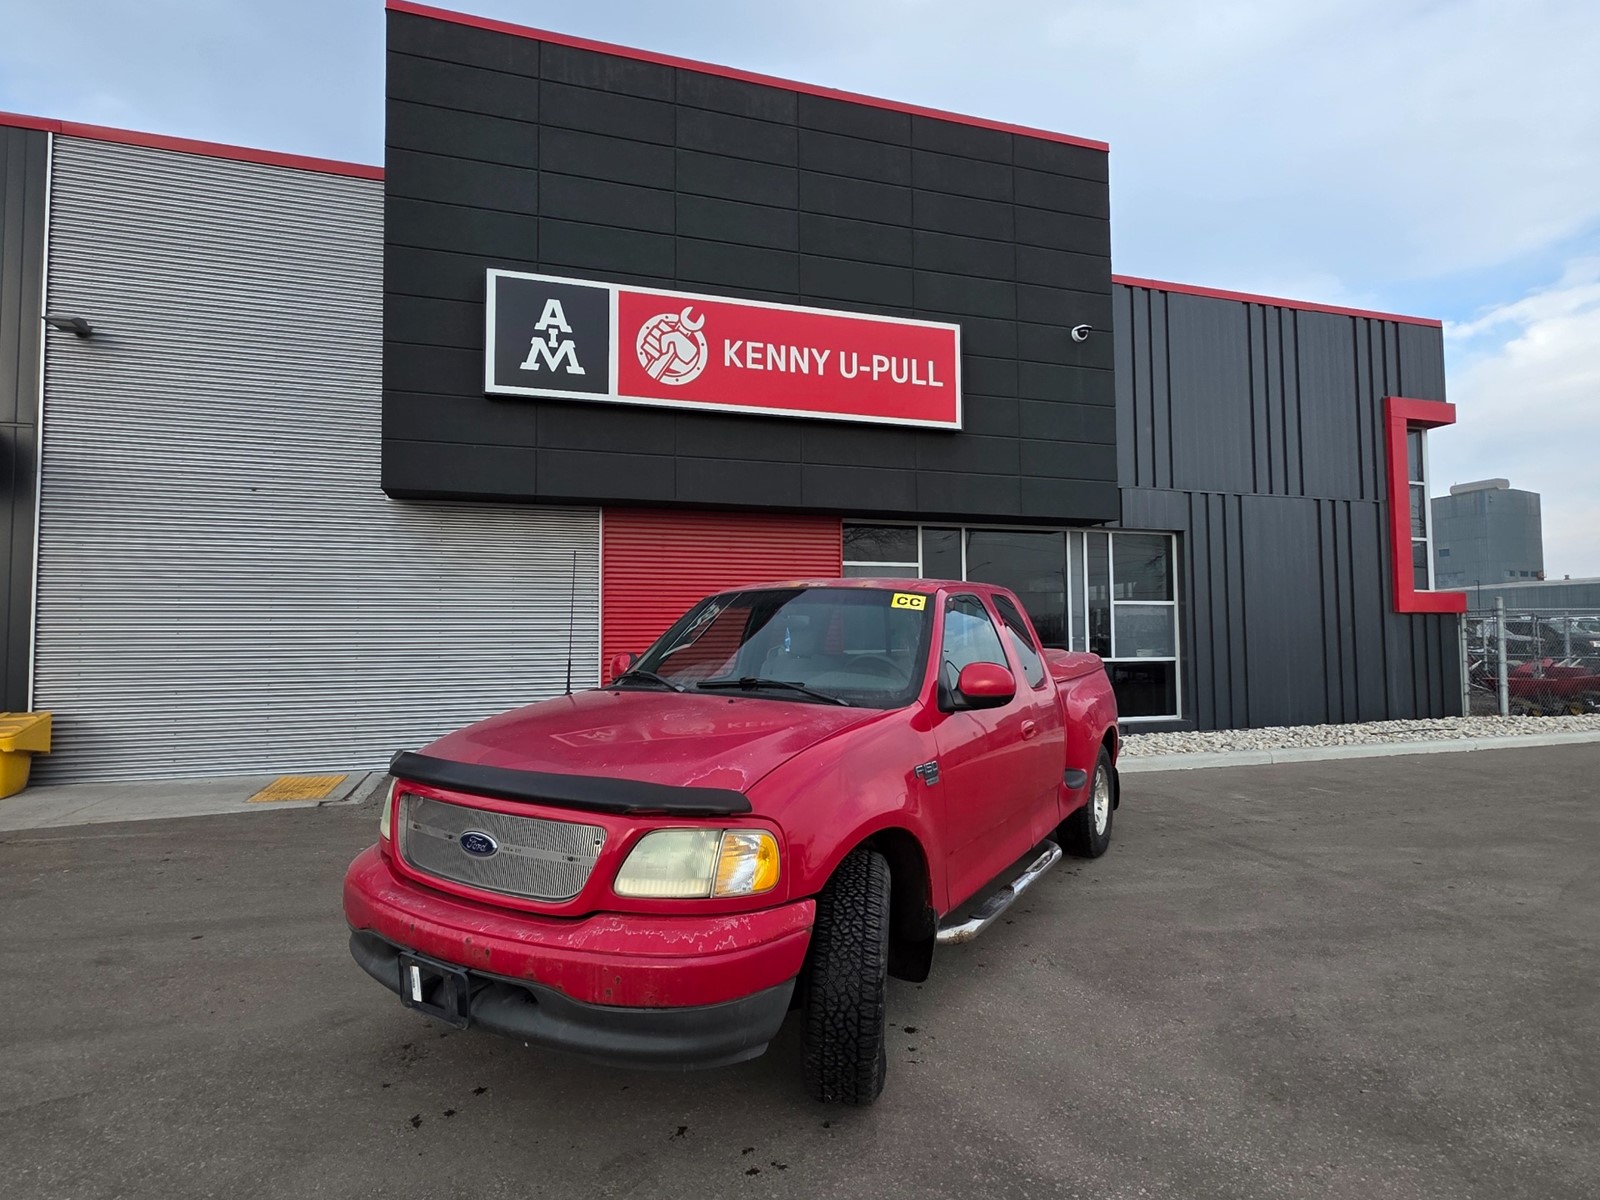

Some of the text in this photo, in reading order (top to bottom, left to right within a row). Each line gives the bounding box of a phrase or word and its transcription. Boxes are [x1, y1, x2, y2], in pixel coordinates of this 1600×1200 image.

[724, 339, 944, 387] KENNY U-PULL
[897, 596, 921, 607] CC
[466, 835, 488, 852] Ford
